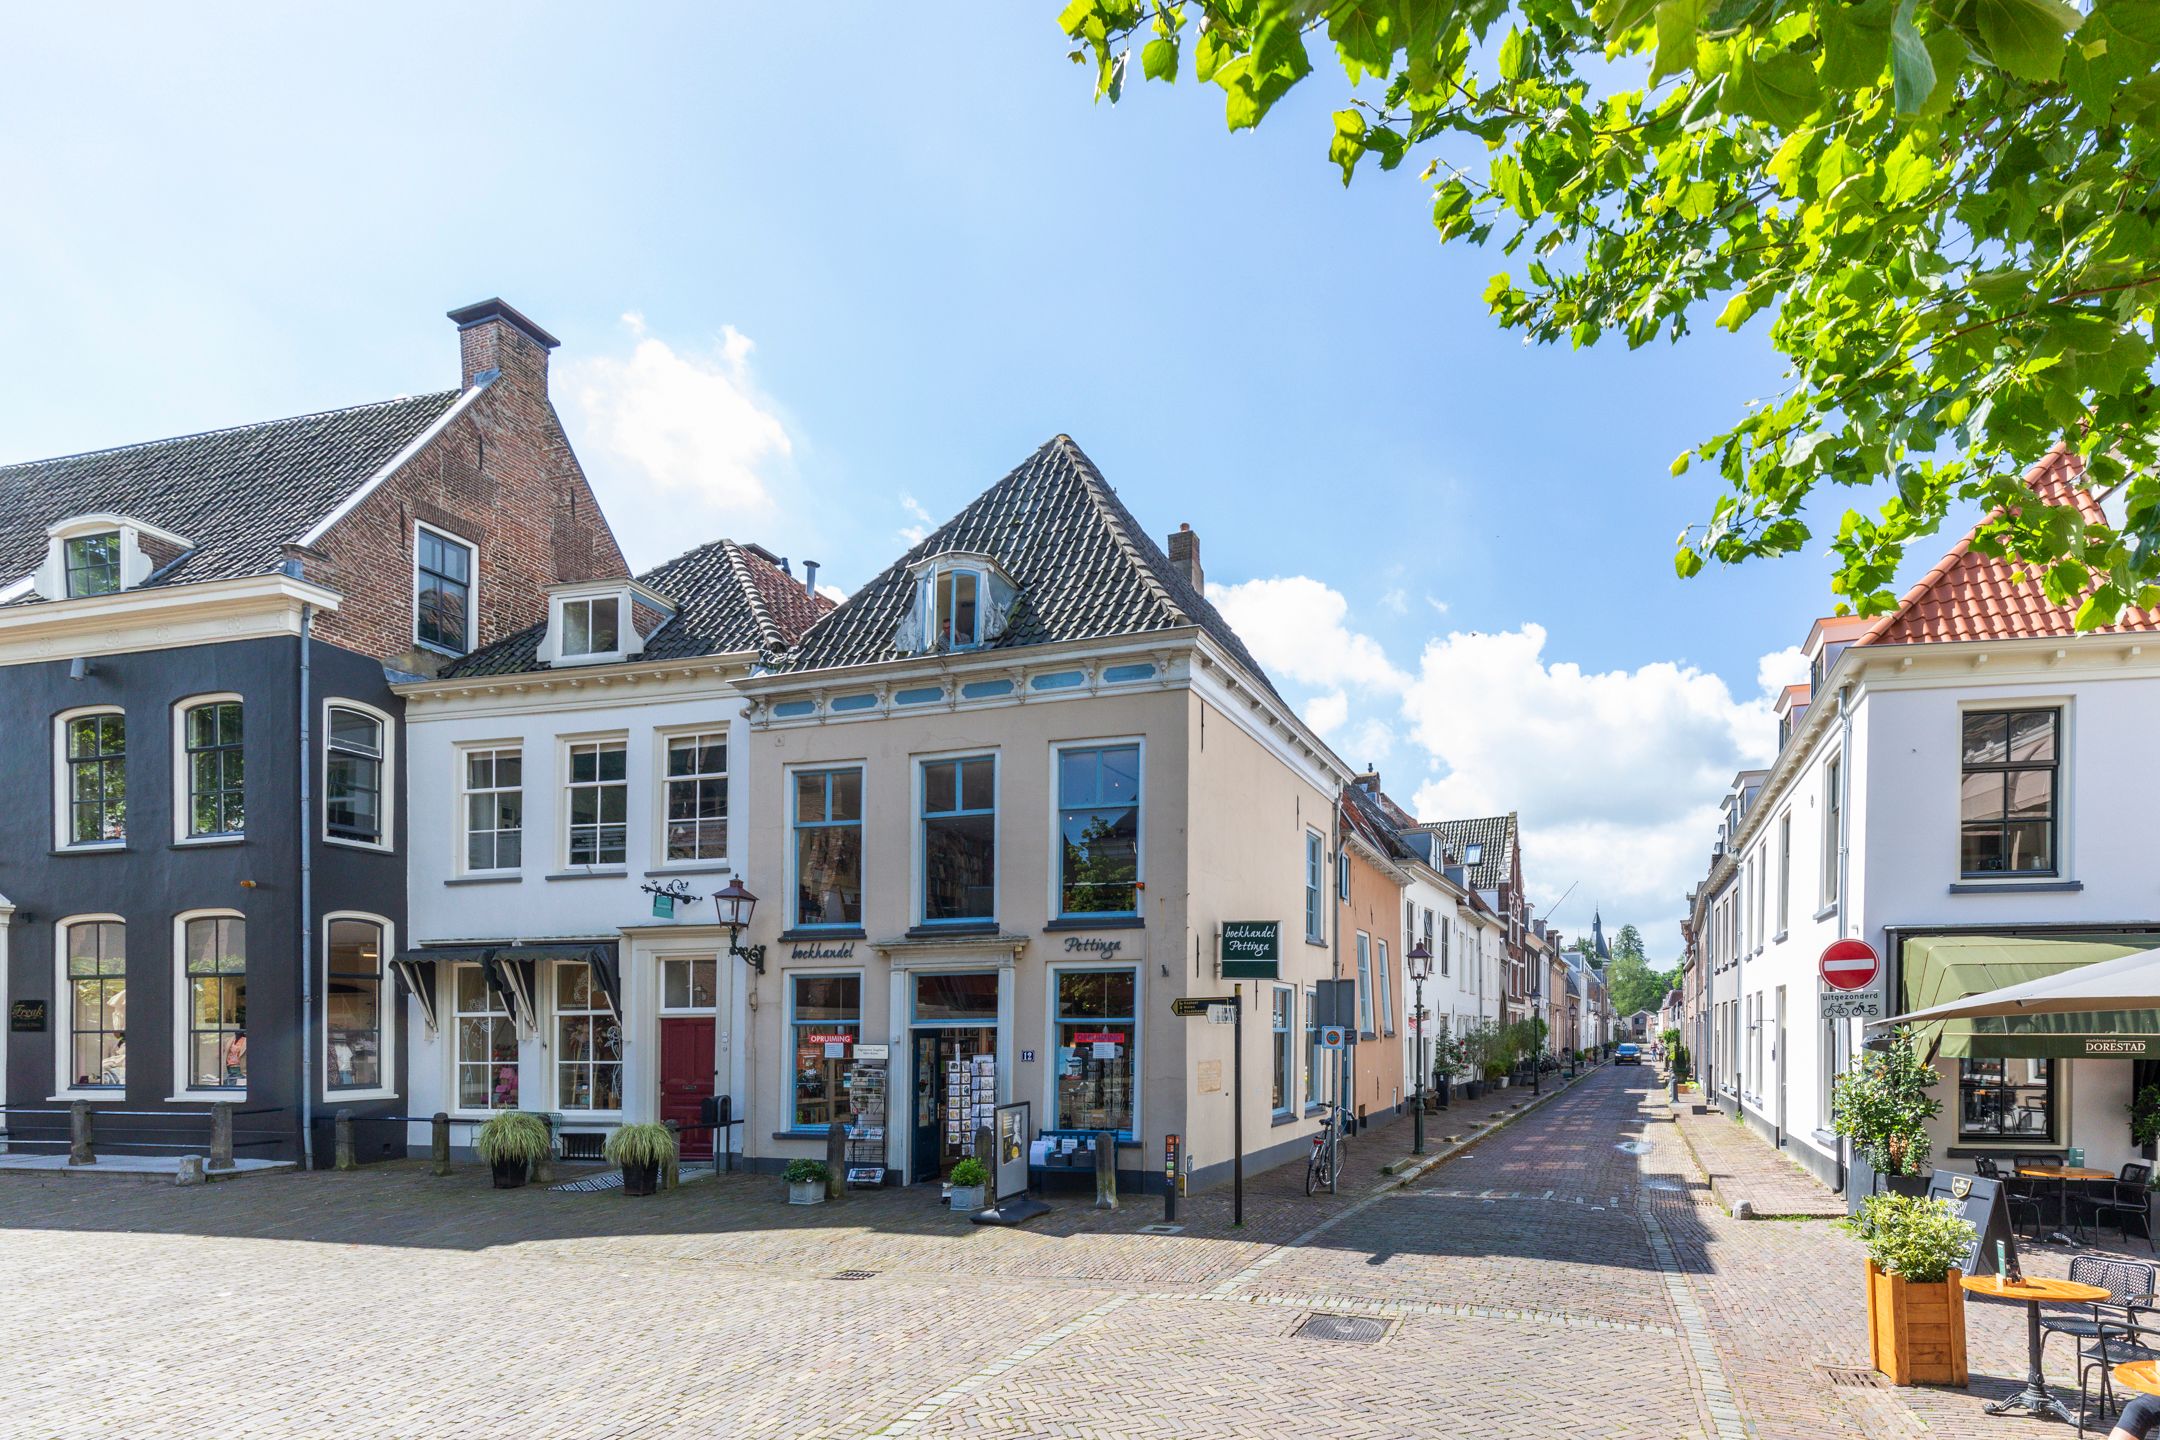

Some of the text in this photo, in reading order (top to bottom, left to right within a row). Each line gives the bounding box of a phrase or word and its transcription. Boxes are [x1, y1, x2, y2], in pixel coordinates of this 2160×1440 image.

[1225, 926, 1276, 938] boekhandel
[791, 937, 1122, 960] boekhandel Pettinga
[1229, 940, 1270, 957] Pettinga
[1822, 993, 1878, 1002] uitgezonderd
[2085, 1042, 2146, 1051] DORESTAD
[1023, 1052, 1033, 1060] 12
